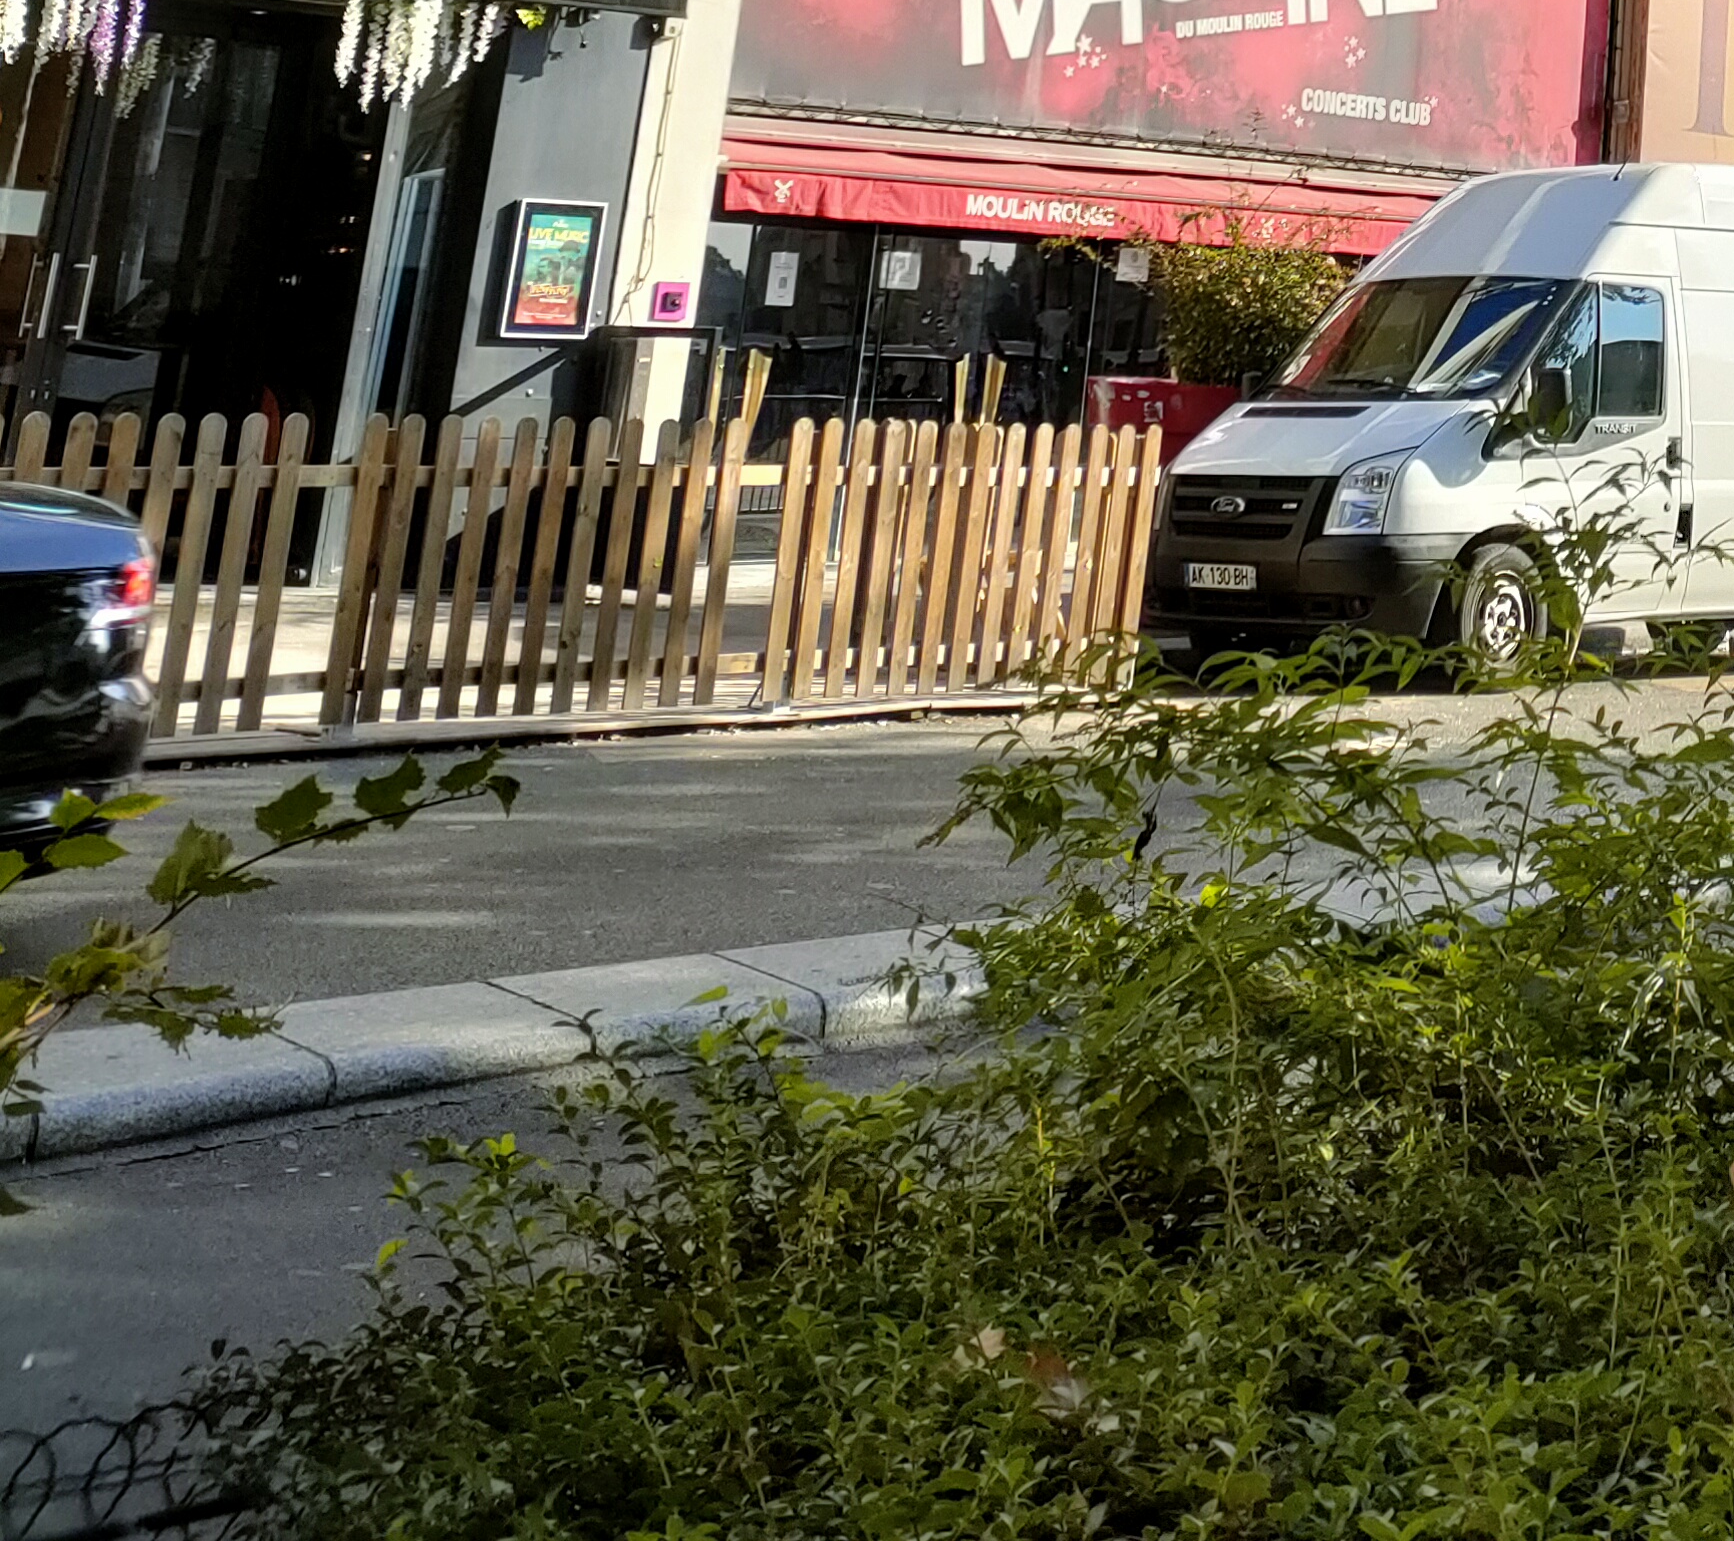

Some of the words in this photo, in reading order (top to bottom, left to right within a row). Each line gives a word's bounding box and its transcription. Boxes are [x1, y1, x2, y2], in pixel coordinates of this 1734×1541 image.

[1175, 20, 1194, 39] DU
[1196, 14, 1243, 36] MOULIN
[1244, 10, 1284, 30] ROUGE
[1301, 88, 1387, 123] CONCERTS
[1388, 99, 1432, 127] CLUB
[966, 193, 1045, 221] MOULIN
[1047, 201, 1115, 227] ROUGE
[528, 227, 554, 240] LIVE
[1594, 423, 1638, 434] TRANSIT
